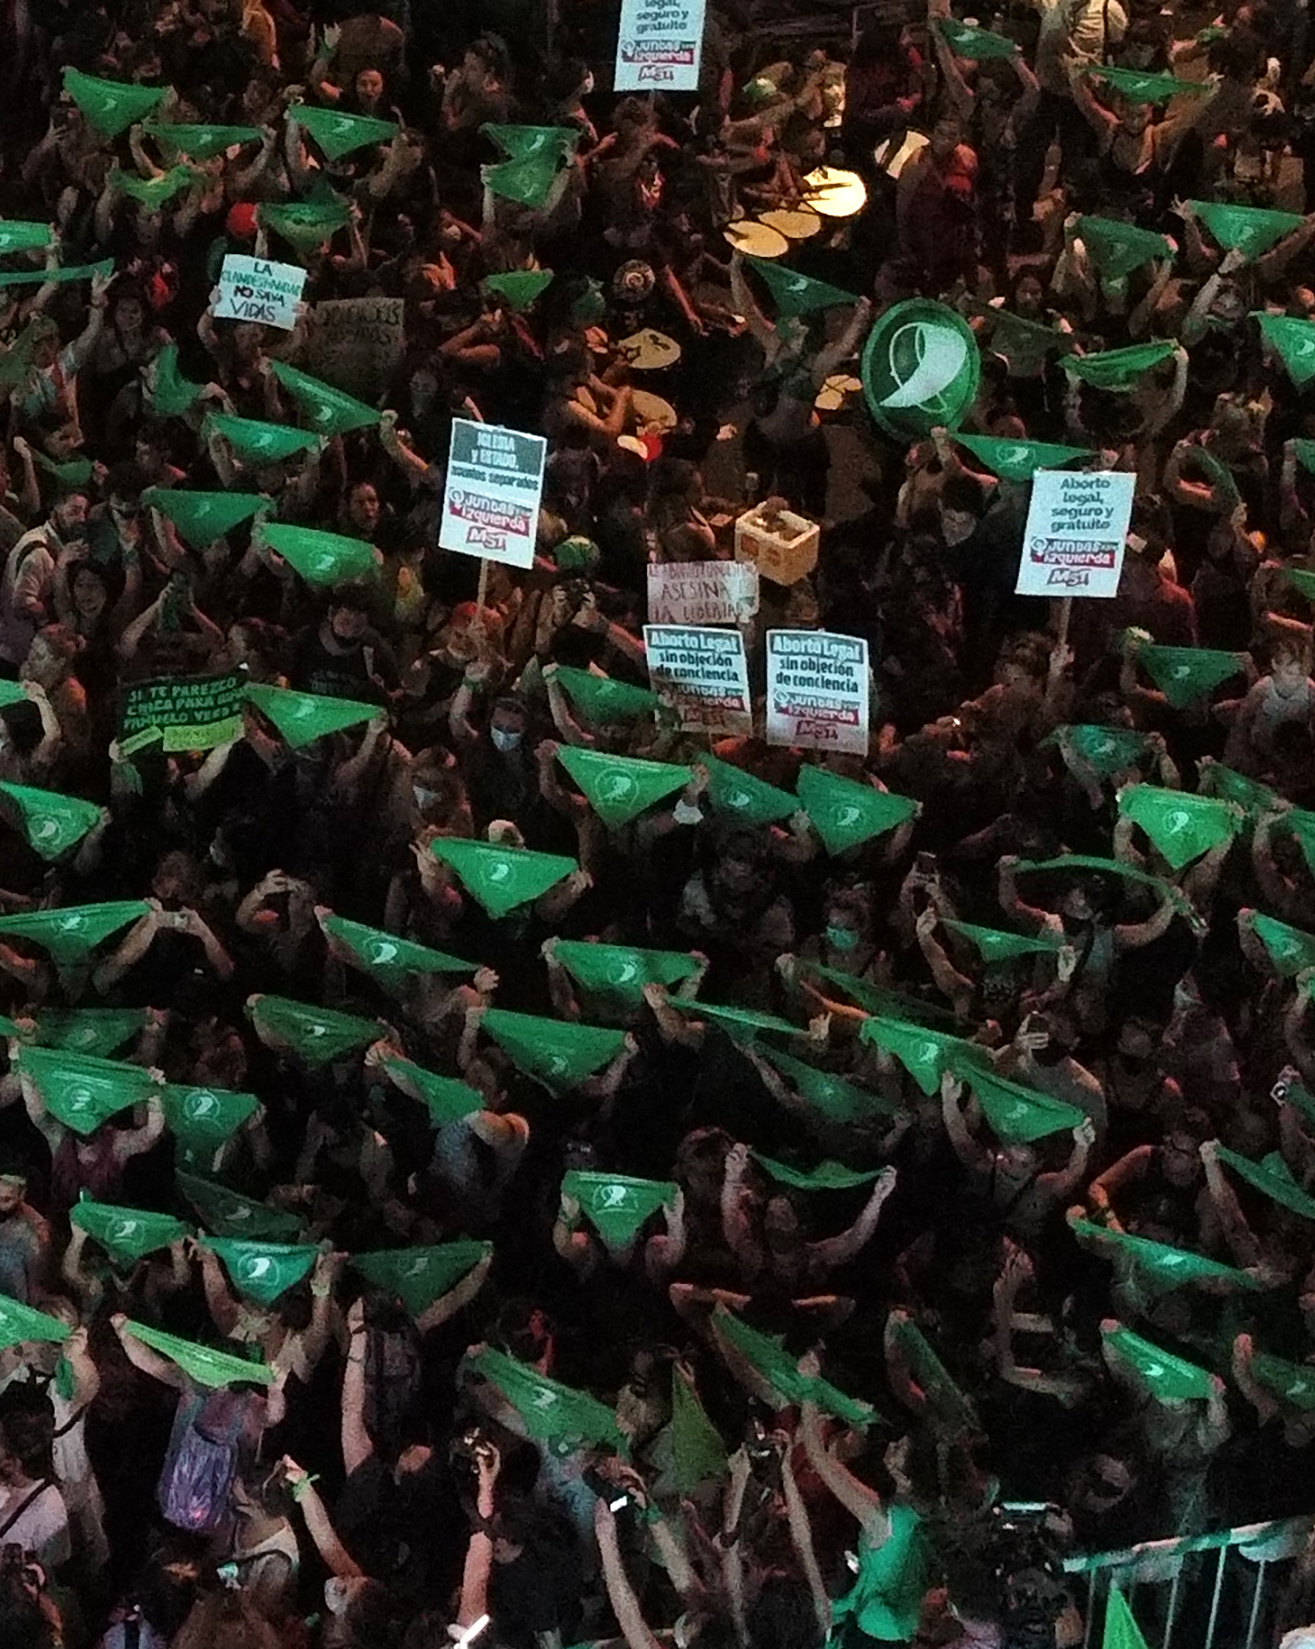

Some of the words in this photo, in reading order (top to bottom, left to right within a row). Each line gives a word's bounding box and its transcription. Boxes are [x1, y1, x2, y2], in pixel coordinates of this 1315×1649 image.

[637, 10, 680, 21] seguro
[681, 10, 689, 20] y
[636, 20, 687, 34] gratuito
[254, 262, 273, 277] LA
[234, 285, 254, 298] NO
[230, 298, 276, 322] VIDAS
[477, 432, 515, 452] IGLESIA
[488, 472, 539, 491] separados
[1060, 477, 1111, 490] Aborto
[1051, 507, 1103, 520] seguro
[1105, 507, 1114, 519] y
[1051, 519, 1111, 533] gratuito
[466, 525, 508, 551] MST
[1047, 567, 1092, 587] MST
[661, 581, 731, 601] ASESINA
[651, 631, 699, 649] Aborto
[700, 634, 738, 653] Legal
[773, 635, 822, 654] Aborto
[823, 641, 861, 661] Legal
[659, 651, 678, 663] sin
[679, 652, 732, 667] objeción
[780, 657, 798, 670] sin
[800, 658, 854, 677] objeción
[656, 664, 672, 676] de
[674, 666, 739, 682] conciencia
[776, 672, 791, 685] de
[793, 675, 859, 692] conciencia
[128, 690, 142, 703] SI
[150, 686, 168, 699] TE
[172, 677, 236, 697] PAREZCO
[176, 696, 214, 711] PARA
